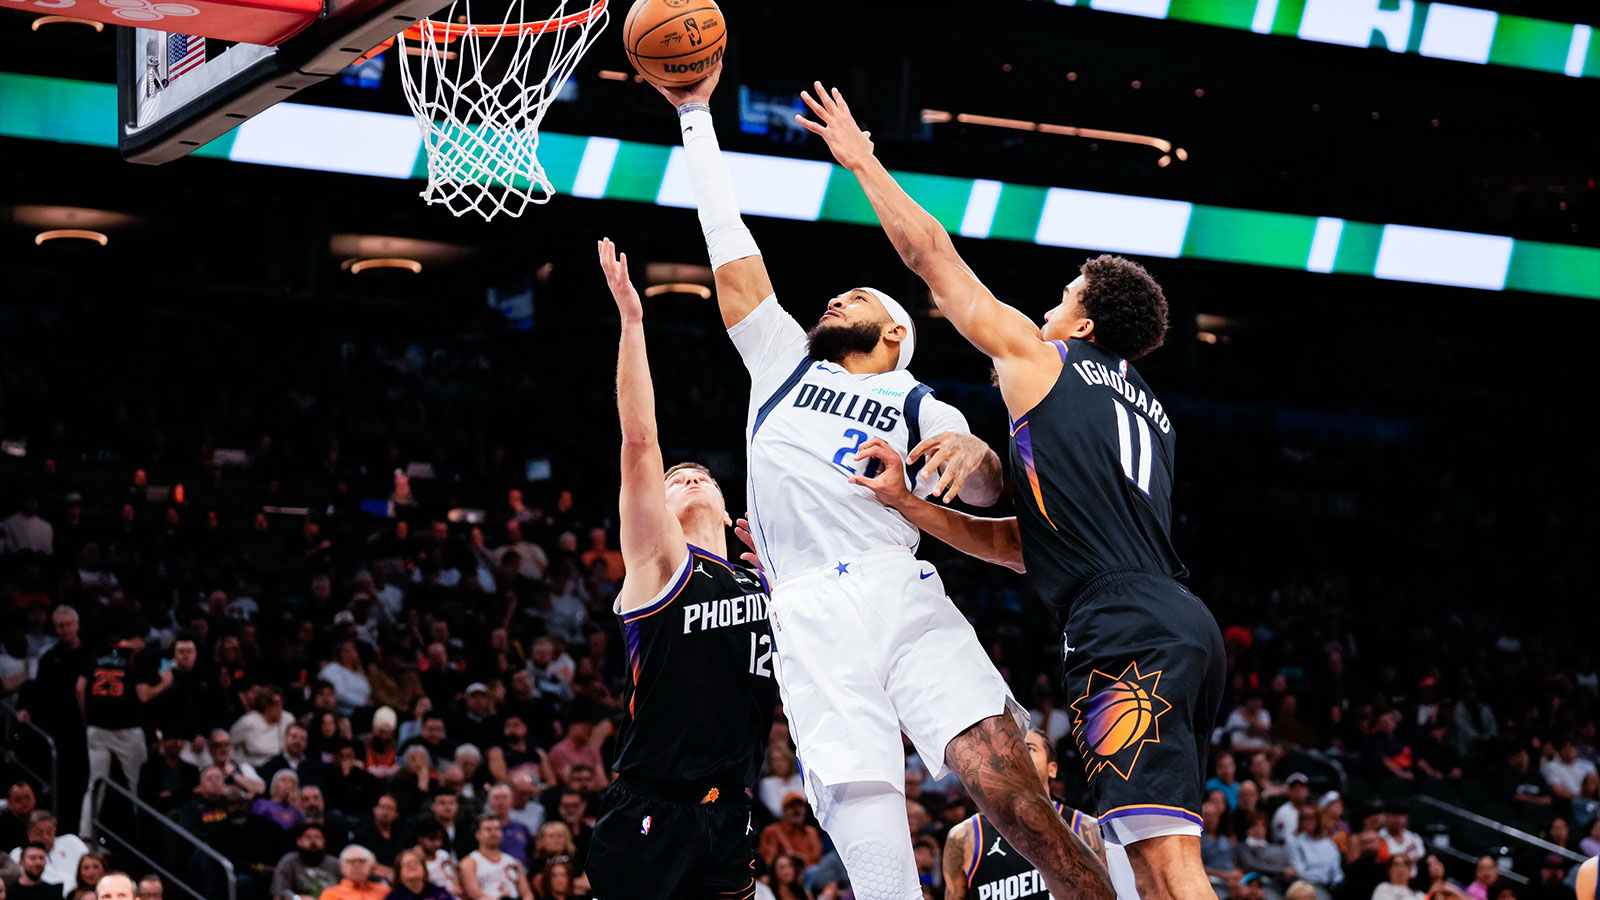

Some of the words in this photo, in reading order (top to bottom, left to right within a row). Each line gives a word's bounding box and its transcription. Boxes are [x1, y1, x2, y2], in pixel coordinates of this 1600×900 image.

[663, 45, 723, 74] Wilson
[793, 383, 901, 432] DALLAS
[1111, 398, 1151, 496] 11
[749, 631, 772, 678] 12
